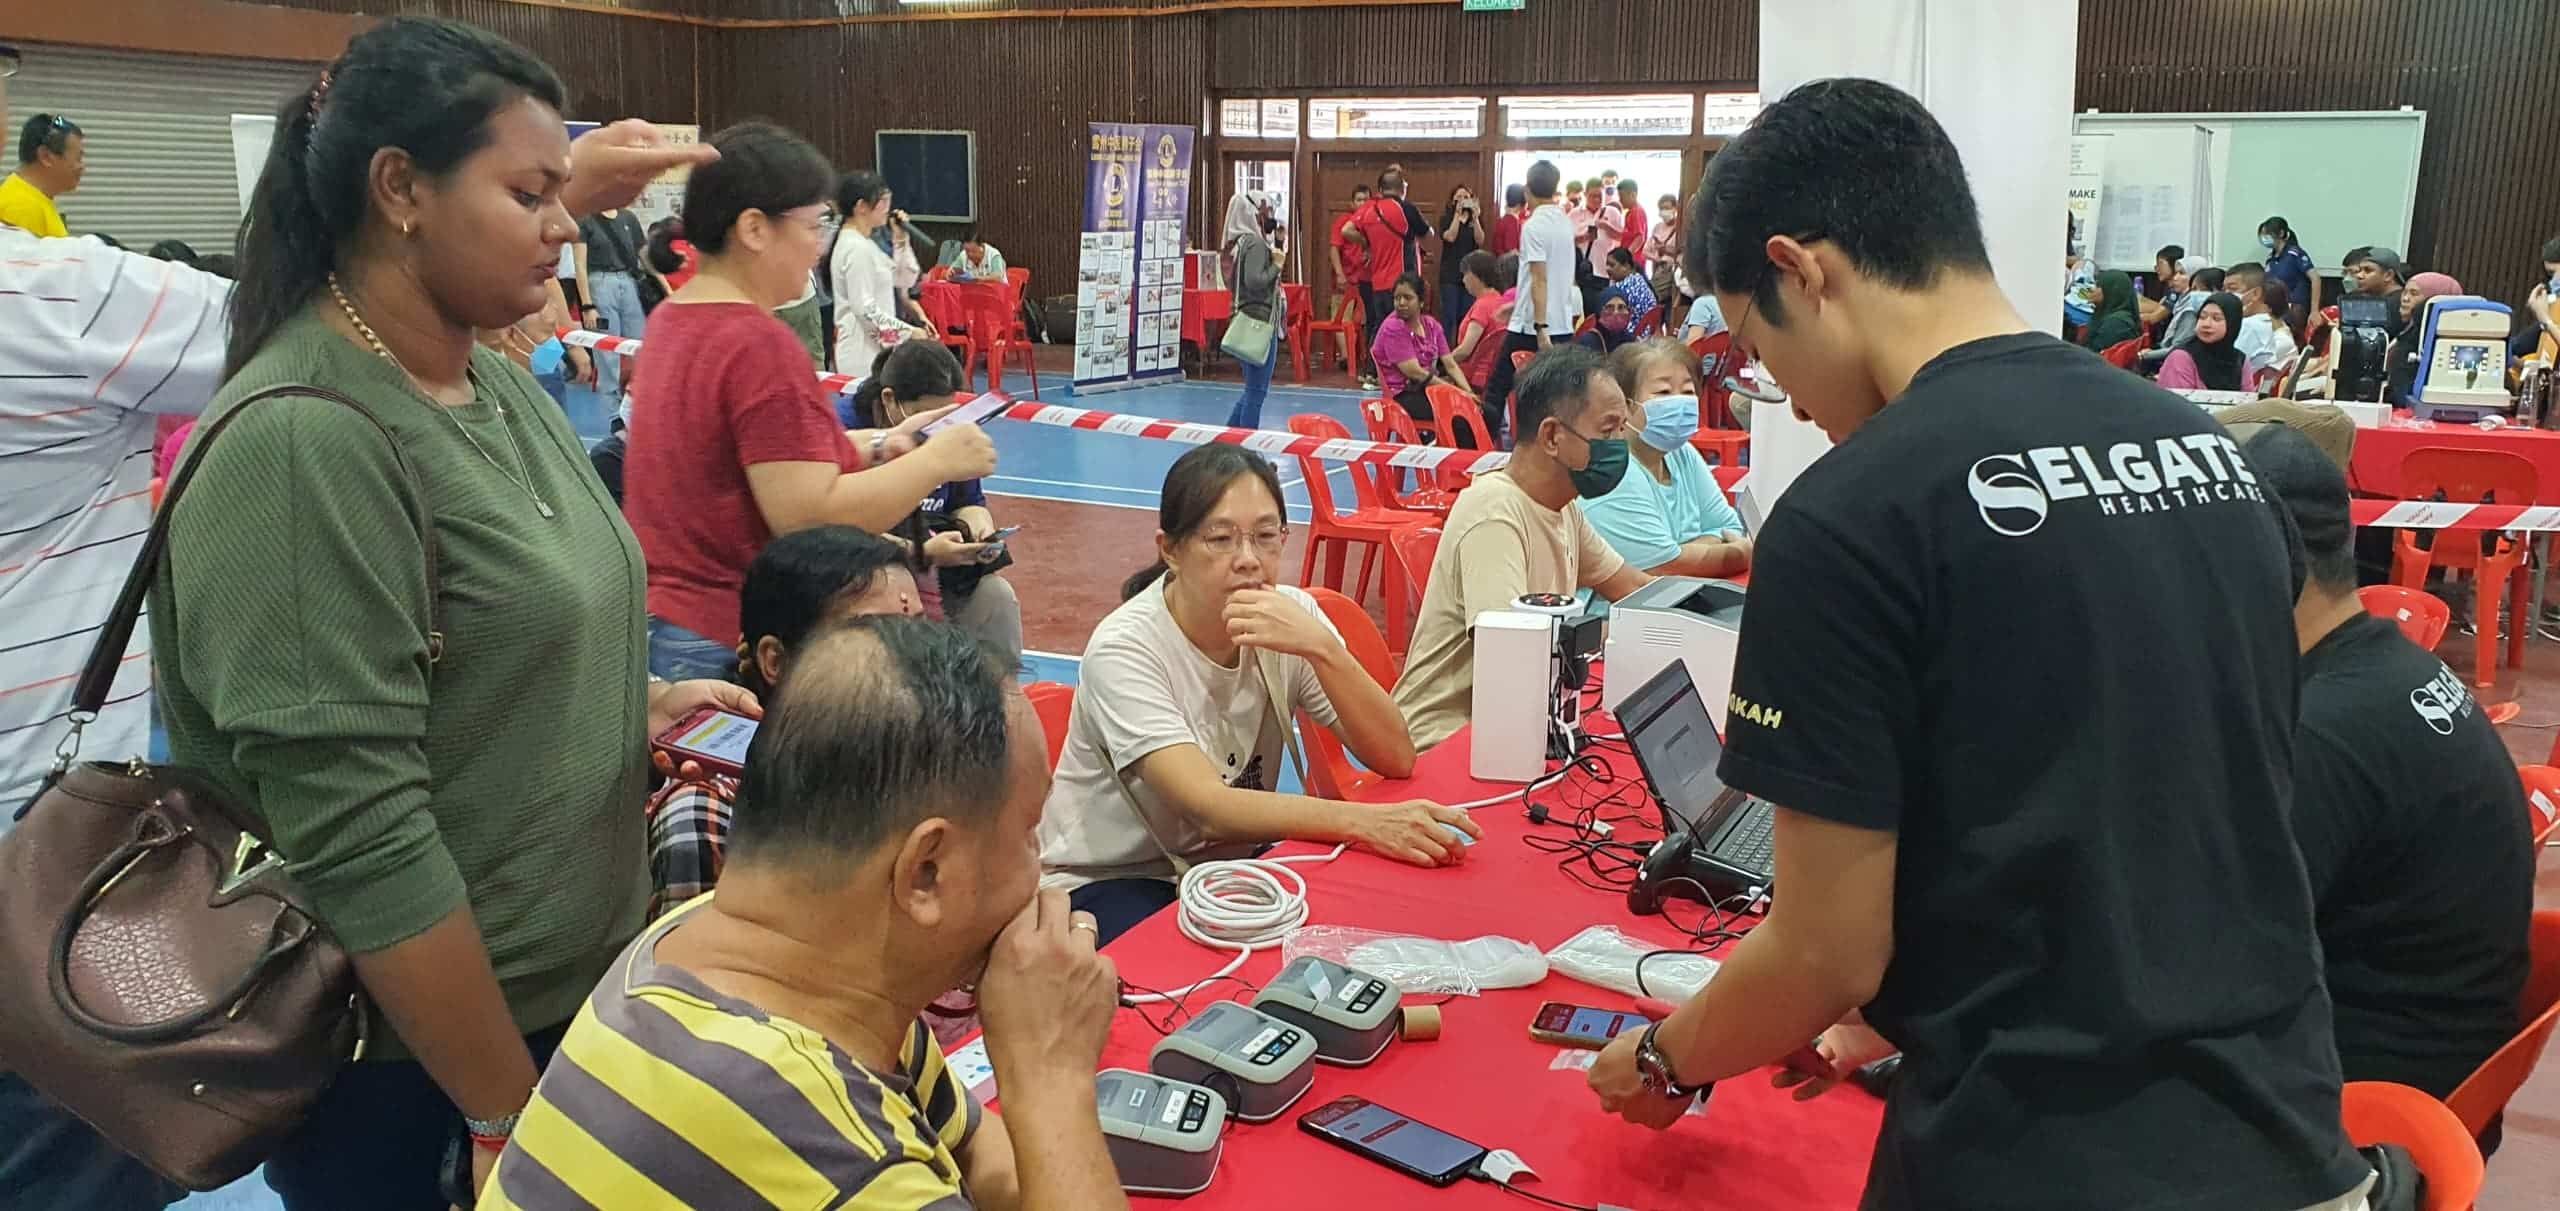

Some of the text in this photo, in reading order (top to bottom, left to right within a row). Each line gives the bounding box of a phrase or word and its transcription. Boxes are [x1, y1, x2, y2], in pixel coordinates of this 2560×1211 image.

[2068, 189, 2096, 199] MAKE
[1967, 433, 2257, 536] SELGATE
[2099, 485, 2266, 516] HEALTHCARE
